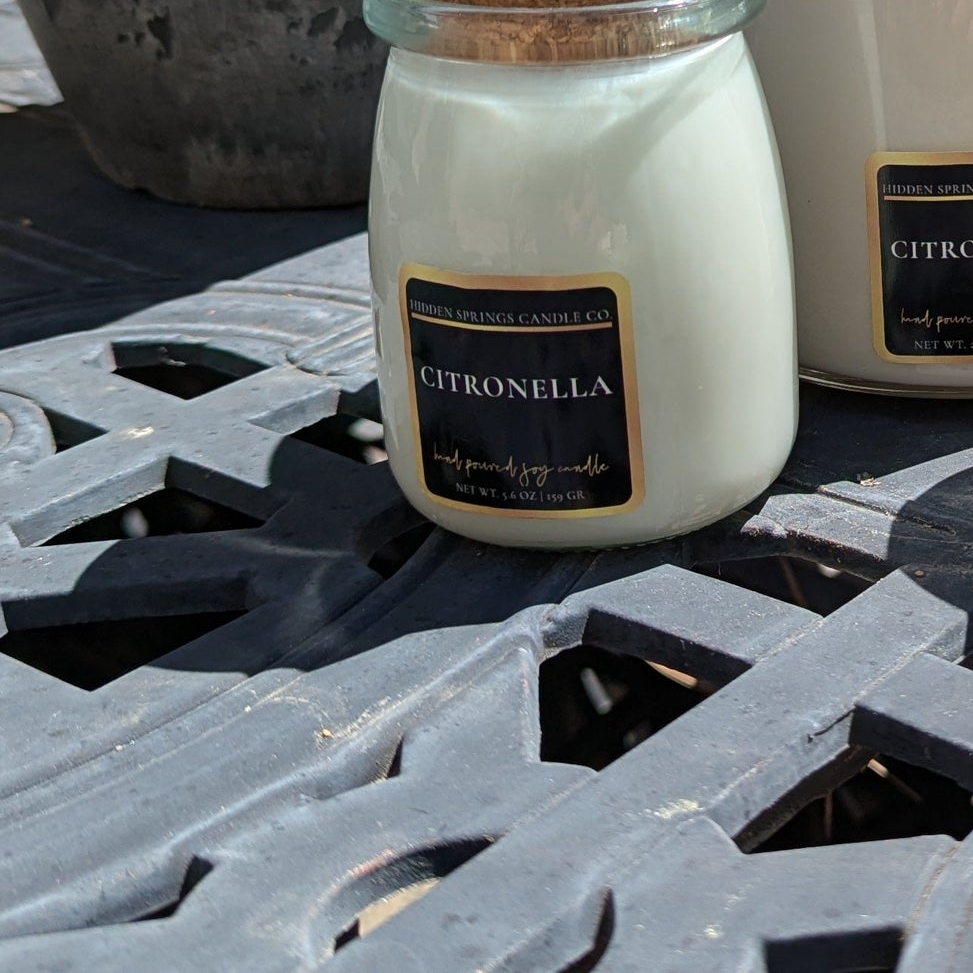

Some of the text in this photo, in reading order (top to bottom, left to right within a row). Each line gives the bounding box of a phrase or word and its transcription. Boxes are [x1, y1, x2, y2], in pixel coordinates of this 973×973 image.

[883, 184, 933, 194] HIDDEN
[410, 299, 452, 319] HIDDEN
[456, 309, 514, 324] SPRINGS
[519, 311, 580, 324] CANDLE
[914, 341, 939, 350] NET
[420, 365, 613, 399] CITRONELLA
[456, 482, 475, 495] NET
[502, 490, 516, 501] 5.6
[520, 491, 537, 501] OZ
[547, 492, 563, 503] 159
[567, 490, 585, 500] GR
